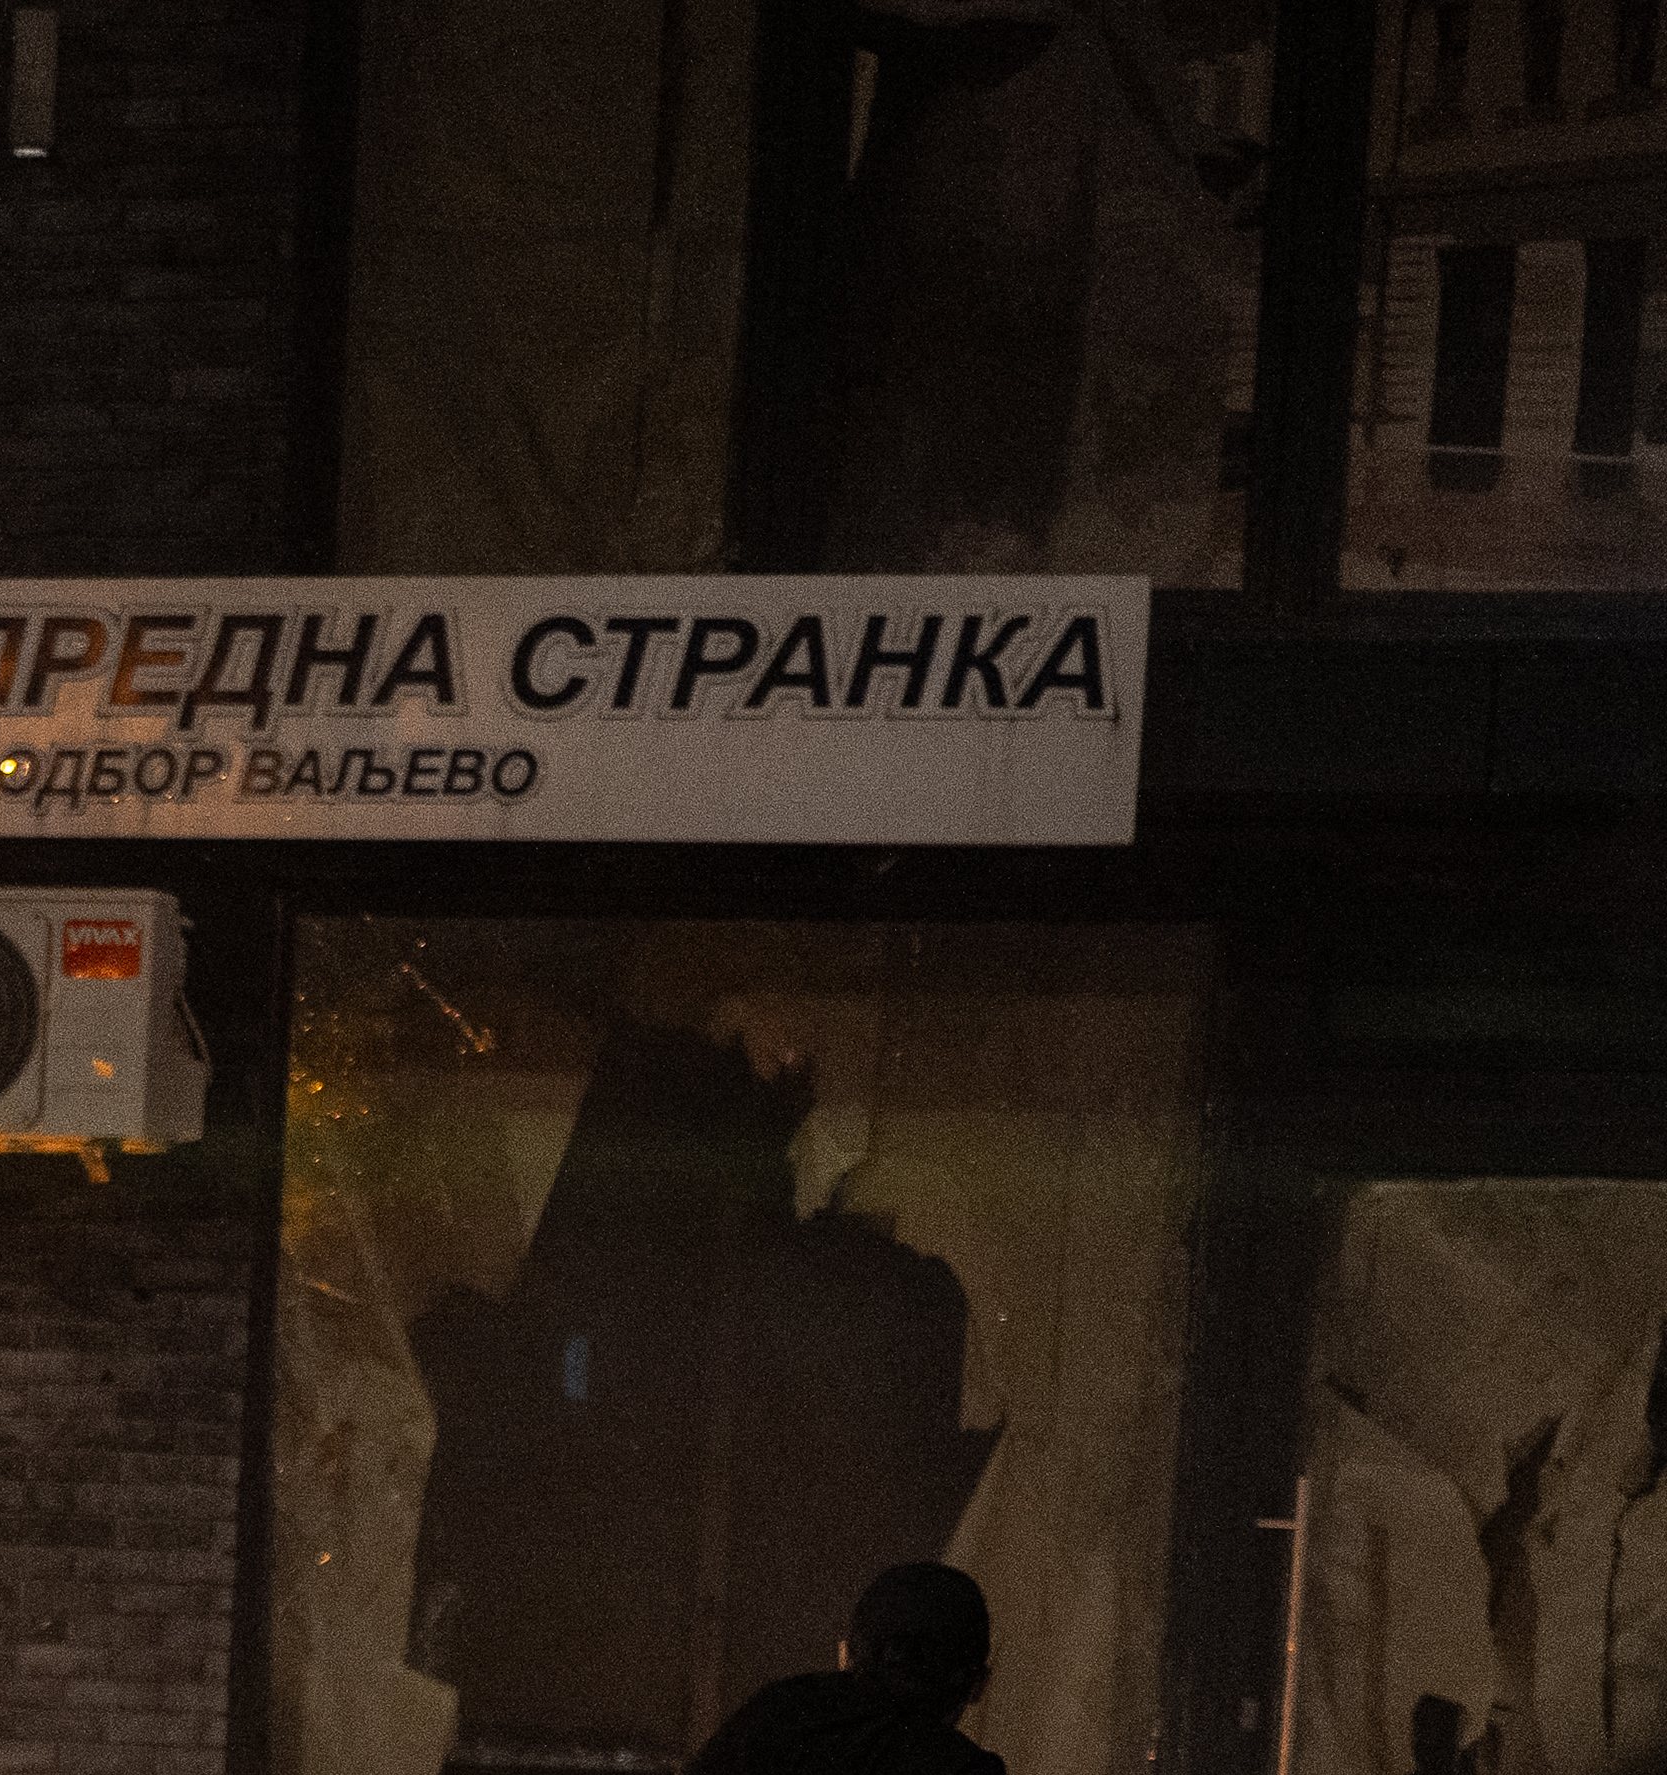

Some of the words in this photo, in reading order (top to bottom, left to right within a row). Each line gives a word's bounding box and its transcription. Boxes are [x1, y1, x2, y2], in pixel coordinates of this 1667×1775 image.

[509, 612, 1107, 710] СТРАНКА
[239, 747, 539, 798] ВАЉЕВО
[66, 926, 141, 946] VIVAX
